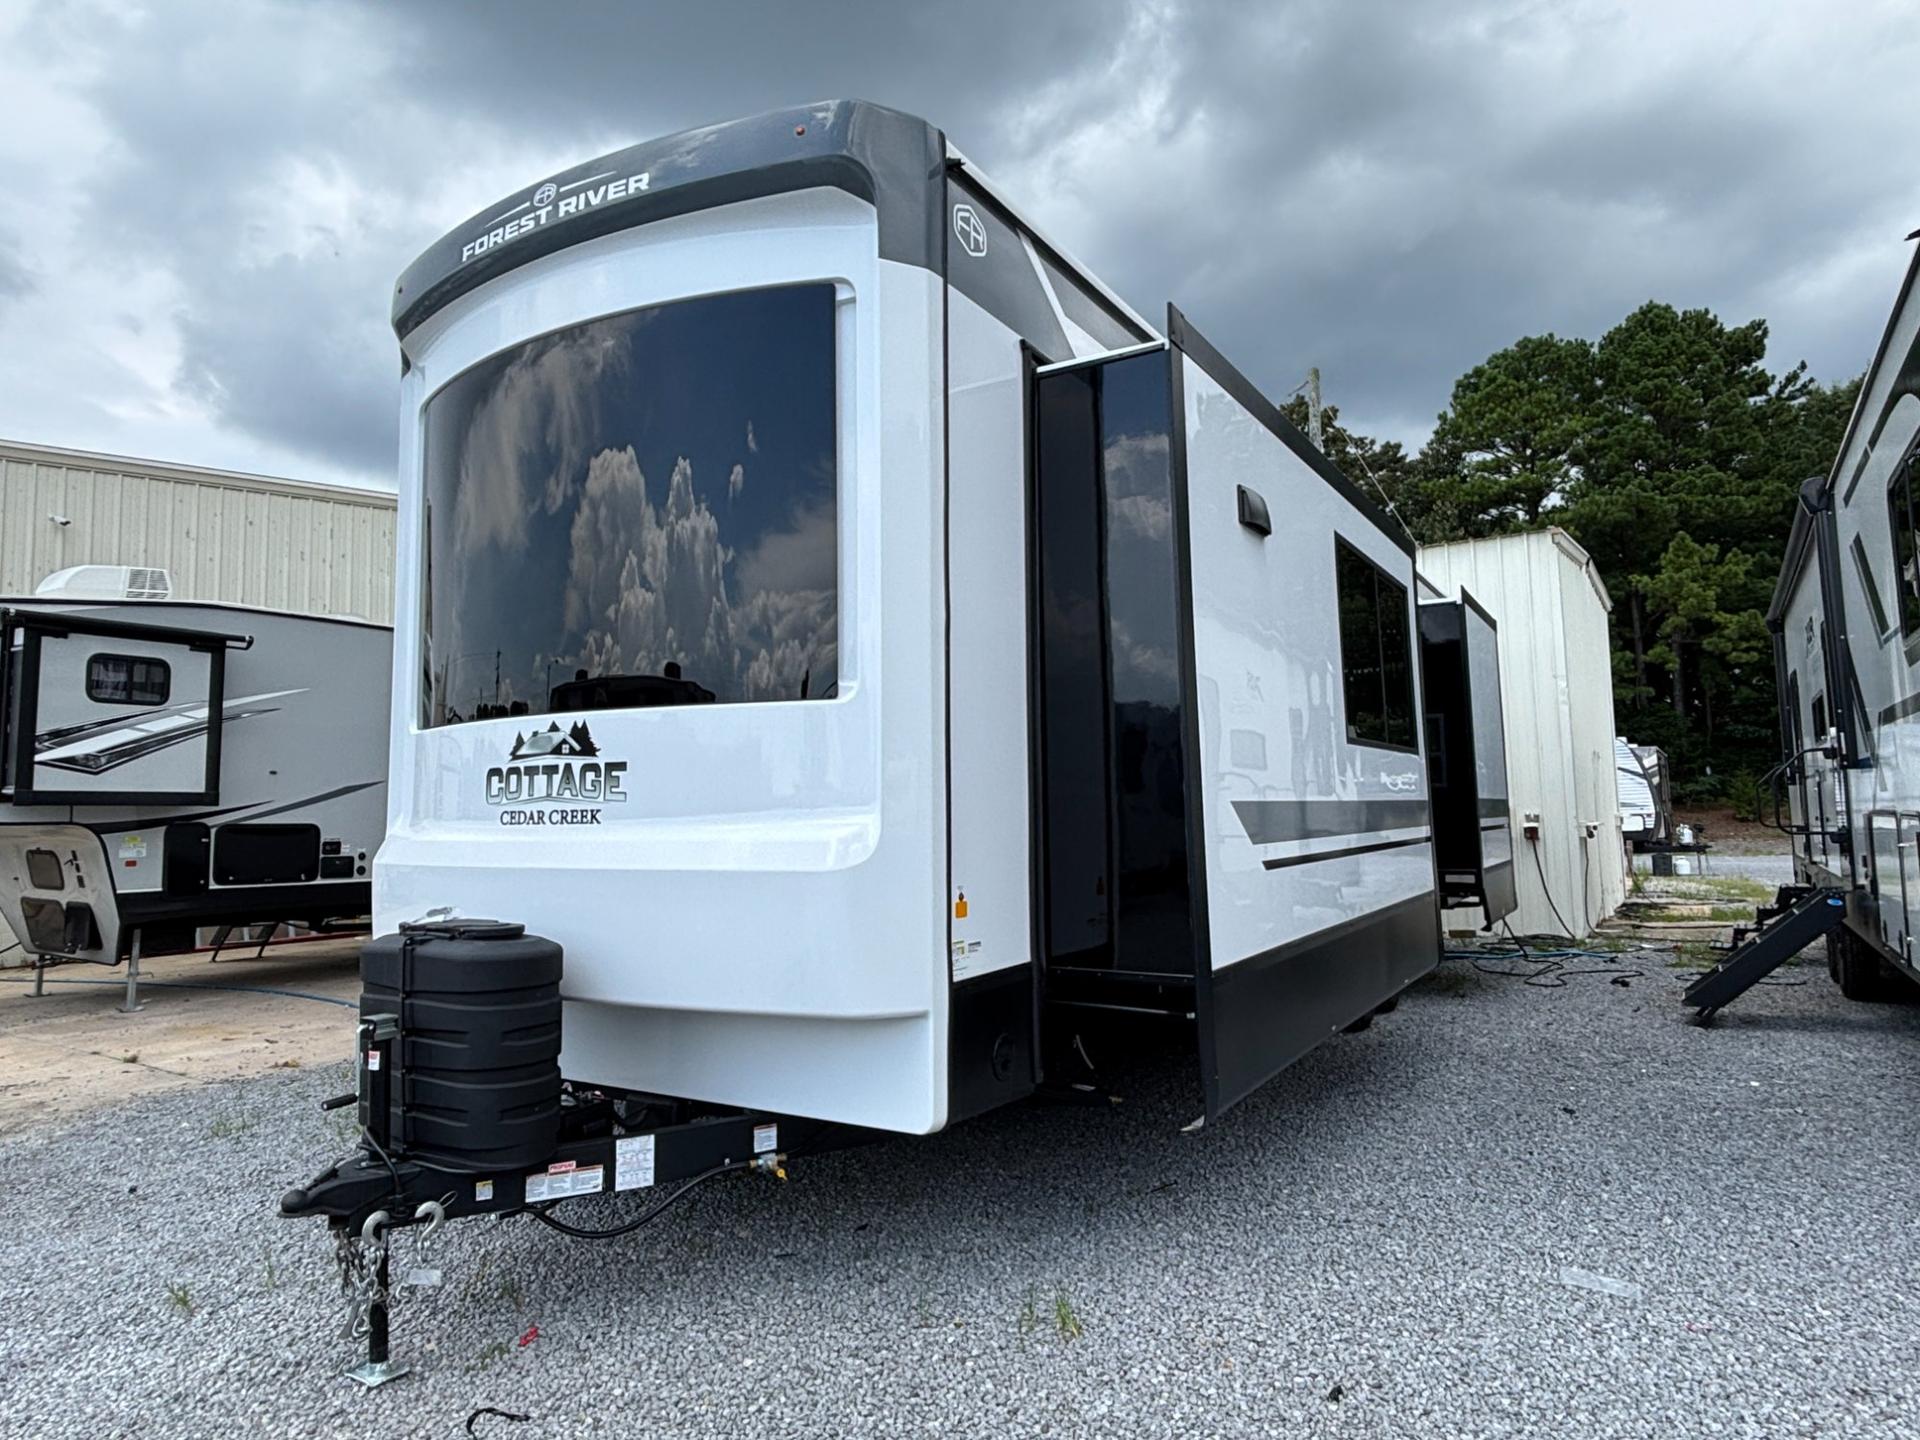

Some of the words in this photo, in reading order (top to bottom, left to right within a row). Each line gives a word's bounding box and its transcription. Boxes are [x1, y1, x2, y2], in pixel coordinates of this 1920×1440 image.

[462, 206, 553, 262] FOREST
[558, 172, 650, 217] RIVER
[486, 761, 628, 805] COTTAGE
[500, 810, 546, 825] CEDAR
[549, 809, 602, 825] CREEK
